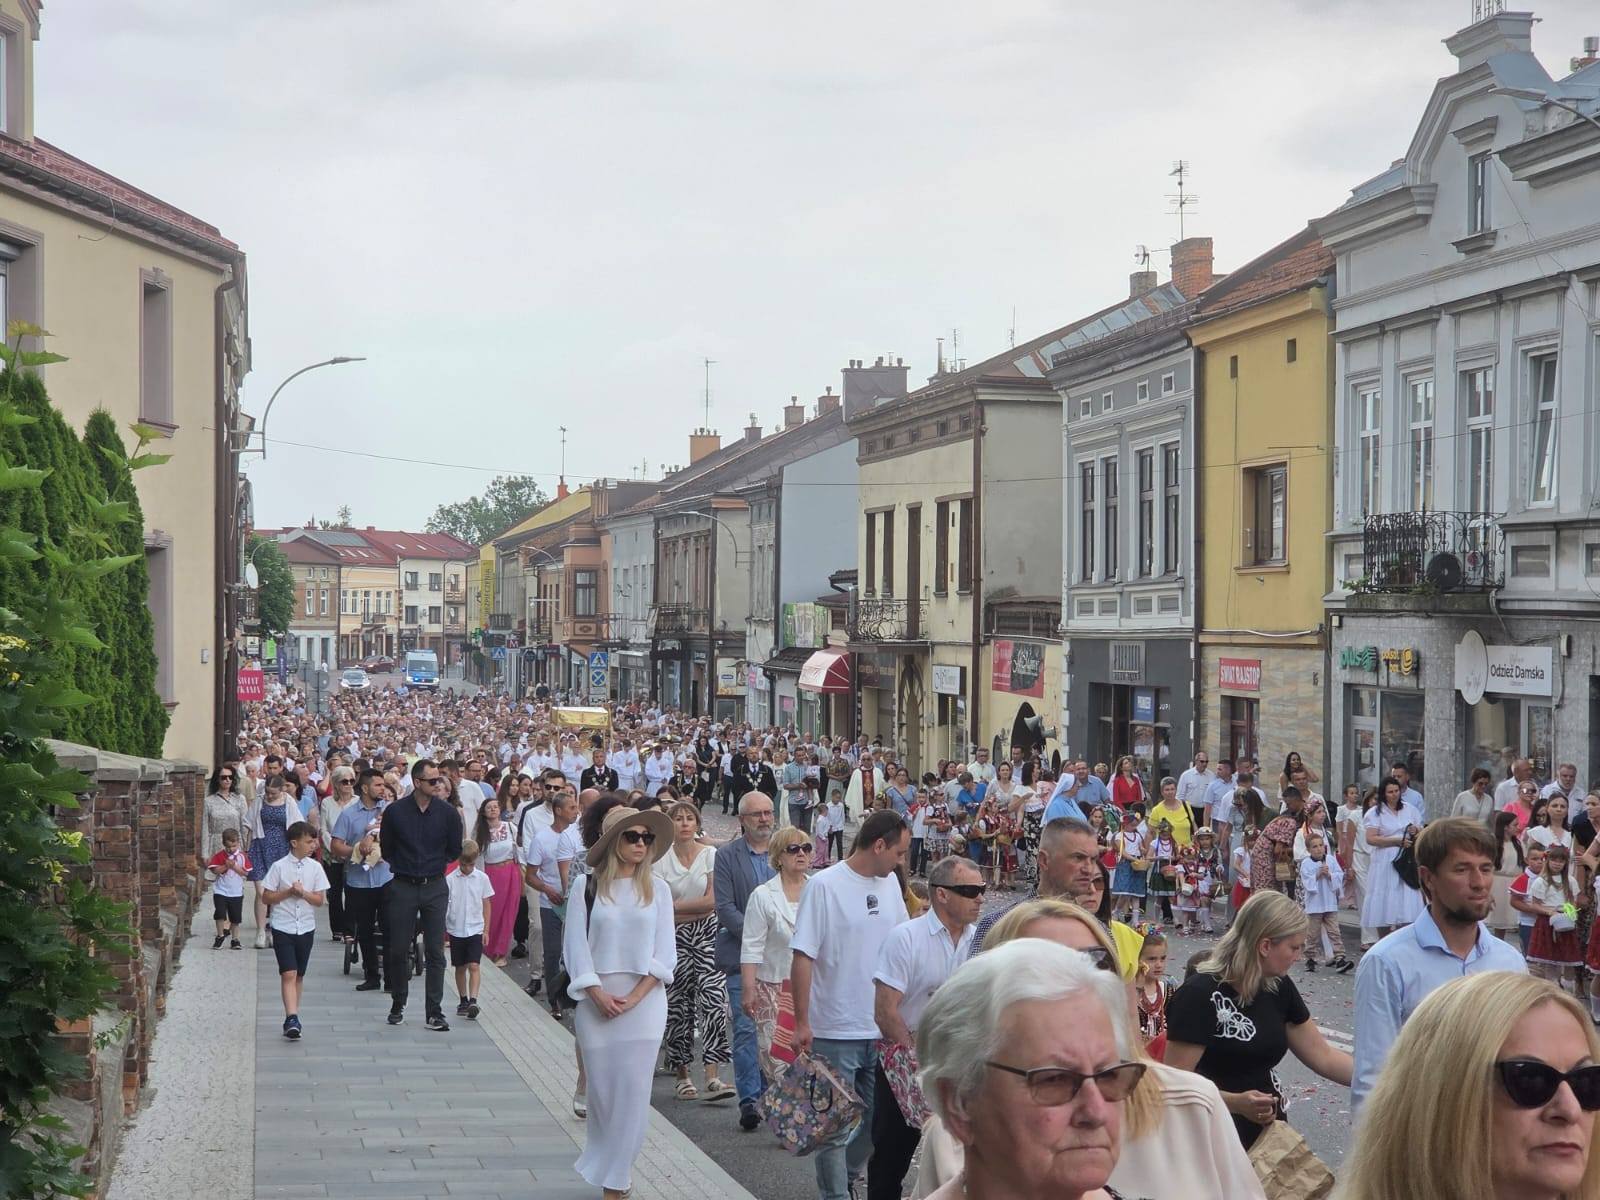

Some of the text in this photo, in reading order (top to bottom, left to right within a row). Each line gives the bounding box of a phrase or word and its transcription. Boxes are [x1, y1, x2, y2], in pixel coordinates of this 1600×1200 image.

[1340, 646, 1361, 670] plus
[1490, 664, 1545, 680] Odzież Damska
